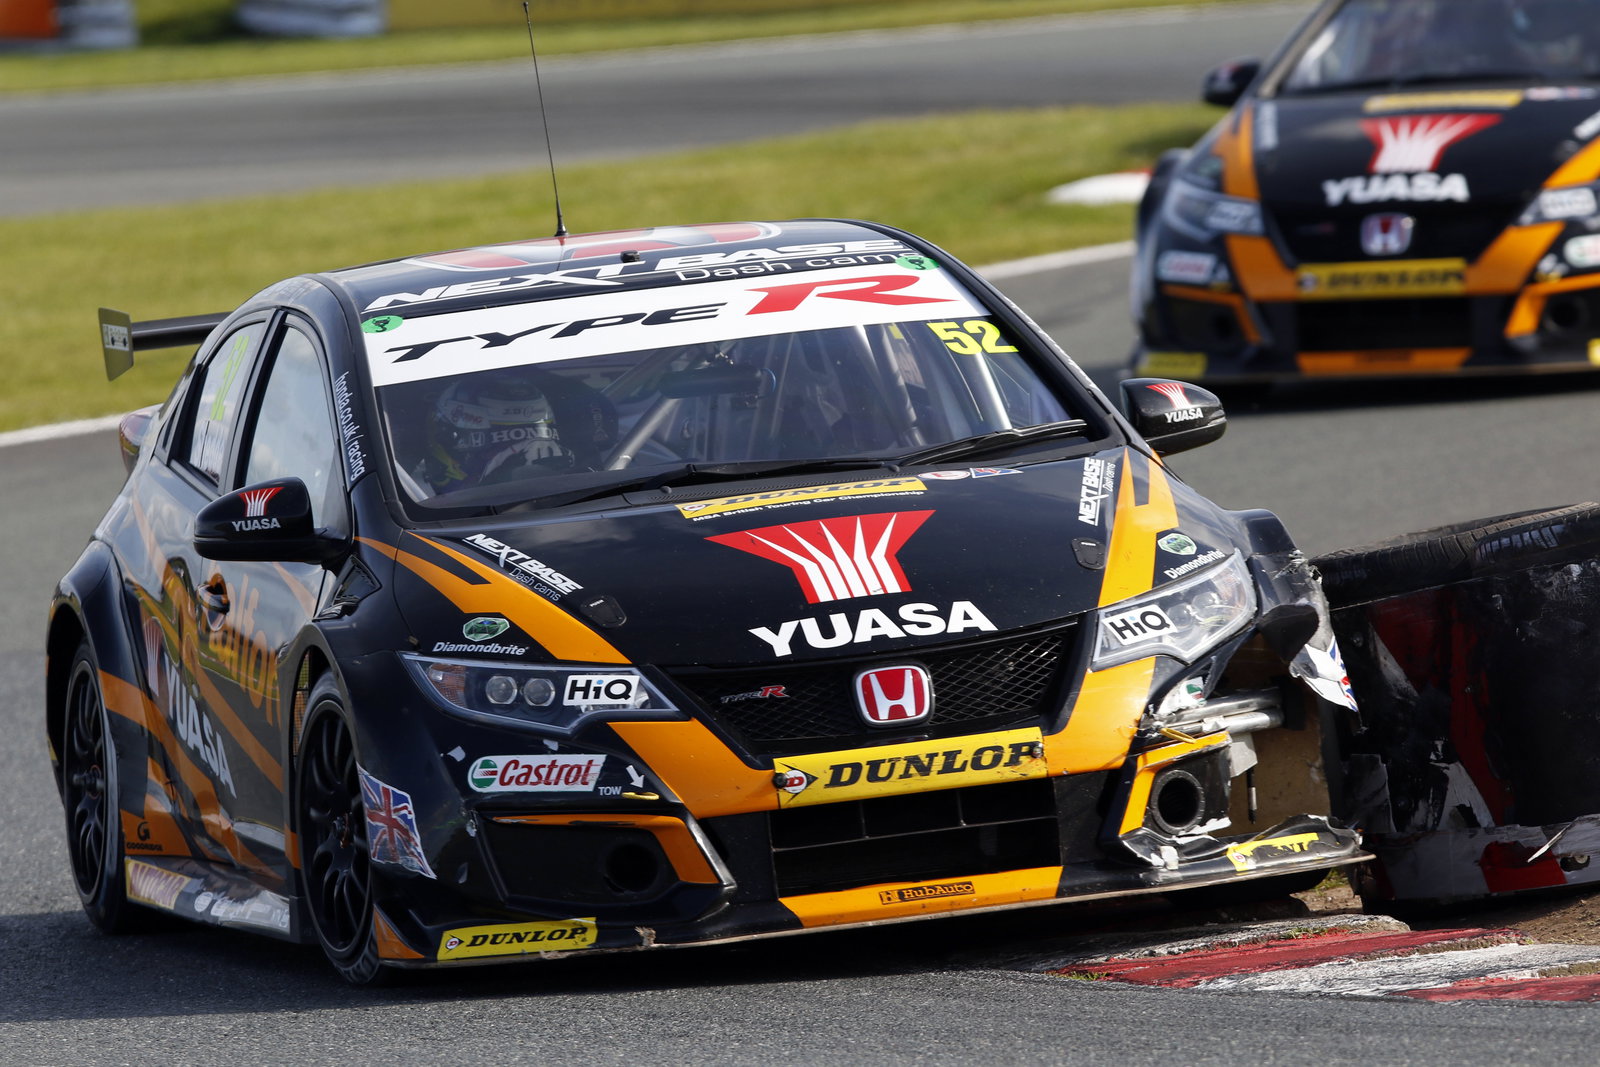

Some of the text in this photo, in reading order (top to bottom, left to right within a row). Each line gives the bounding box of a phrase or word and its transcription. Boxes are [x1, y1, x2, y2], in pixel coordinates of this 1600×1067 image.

[1323, 173, 1470, 206] YUASA
[675, 259, 792, 281] Dash
[384, 275, 959, 364] TYPE R
[927, 321, 1019, 355] 52
[335, 371, 366, 482] honda.co.uk/racing
[1165, 408, 1203, 423] YUASA
[693, 490, 924, 522] MSA British Touring Car Championship
[722, 478, 918, 504] DUNLOP
[232, 518, 281, 531] YUASA
[1164, 549, 1226, 579] Diamondbrite
[509, 568, 561, 601] Dash cams
[748, 601, 999, 657] YUASA
[1109, 610, 1170, 640] HiQ
[432, 642, 527, 656] Diamondbrite
[567, 678, 633, 700] HiQ
[163, 652, 237, 800] YUASA
[499, 759, 595, 786] Castrol
[824, 741, 1044, 789] DUNLOP
[598, 786, 622, 796] TOW
[902, 884, 973, 899] HubAuto
[467, 927, 588, 947] DUNLOP
